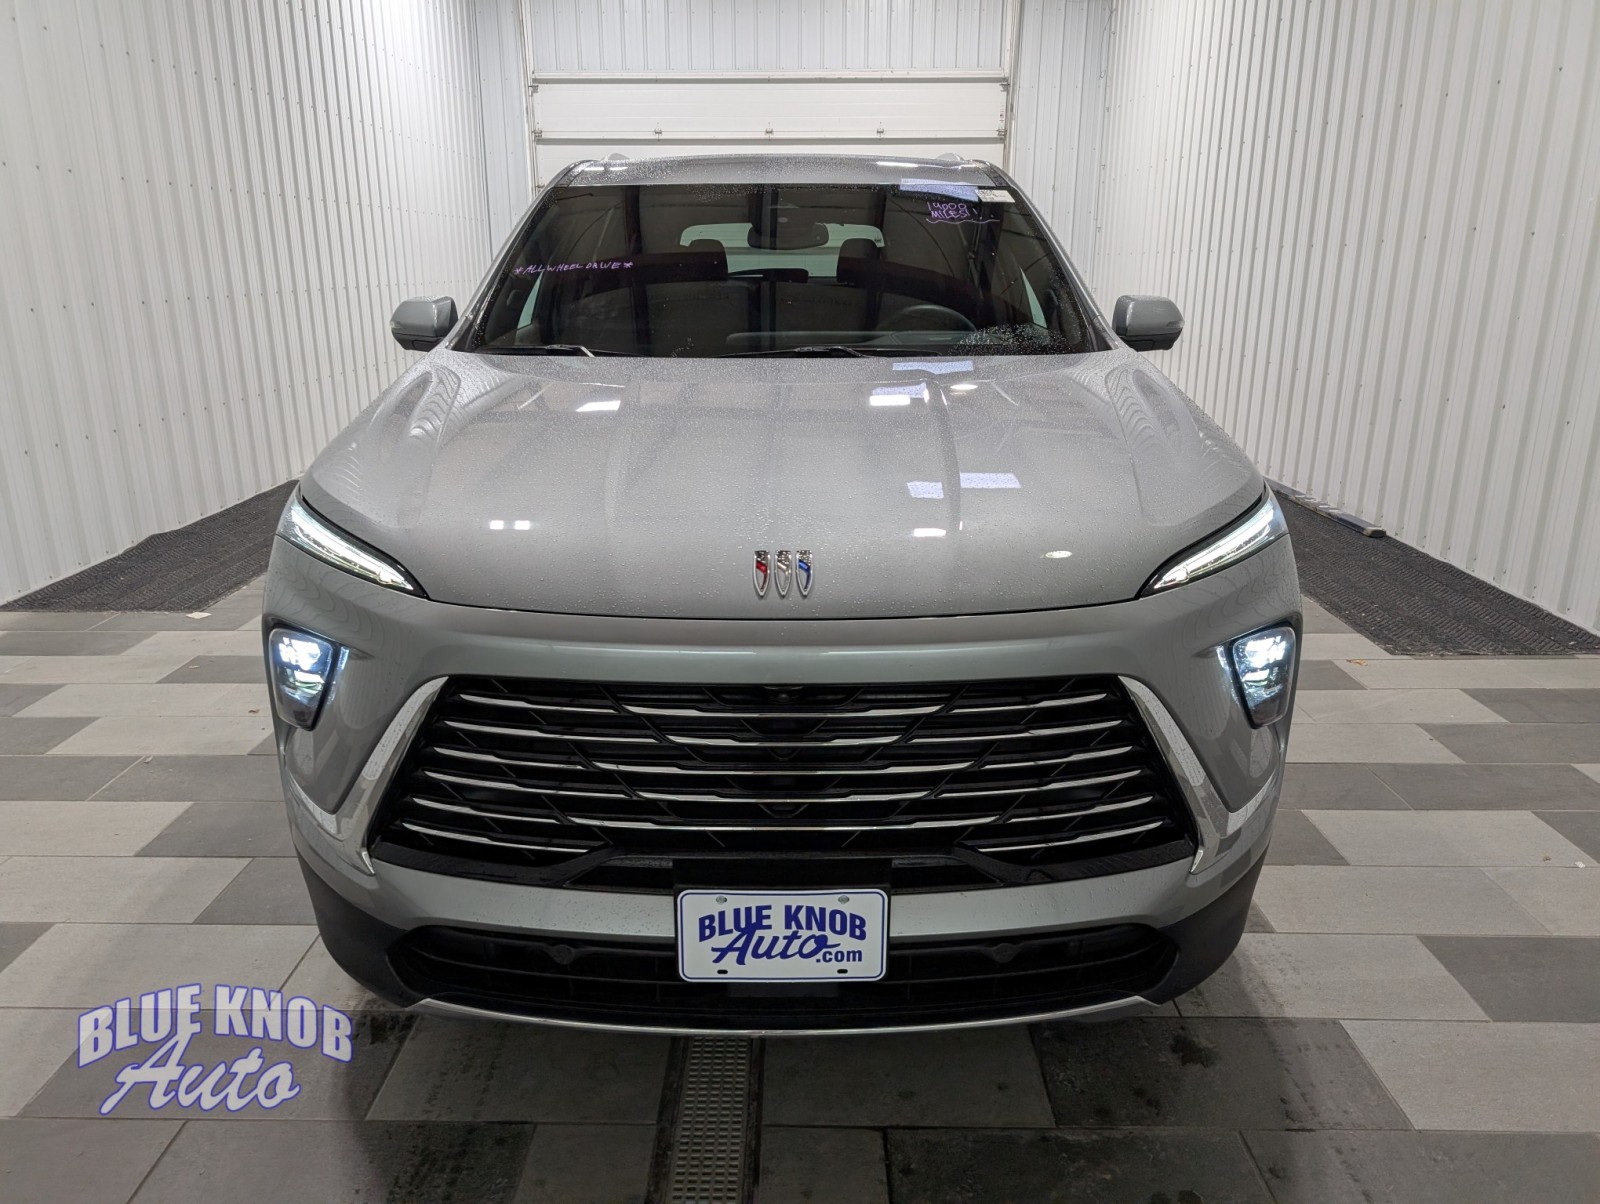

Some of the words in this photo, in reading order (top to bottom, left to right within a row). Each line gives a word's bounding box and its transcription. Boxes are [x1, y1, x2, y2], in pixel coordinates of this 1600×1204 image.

[546, 263, 583, 272] WHEEL
[699, 905, 772, 942] BLUE
[784, 905, 867, 941] KNOB
[711, 925, 841, 965] Auto
